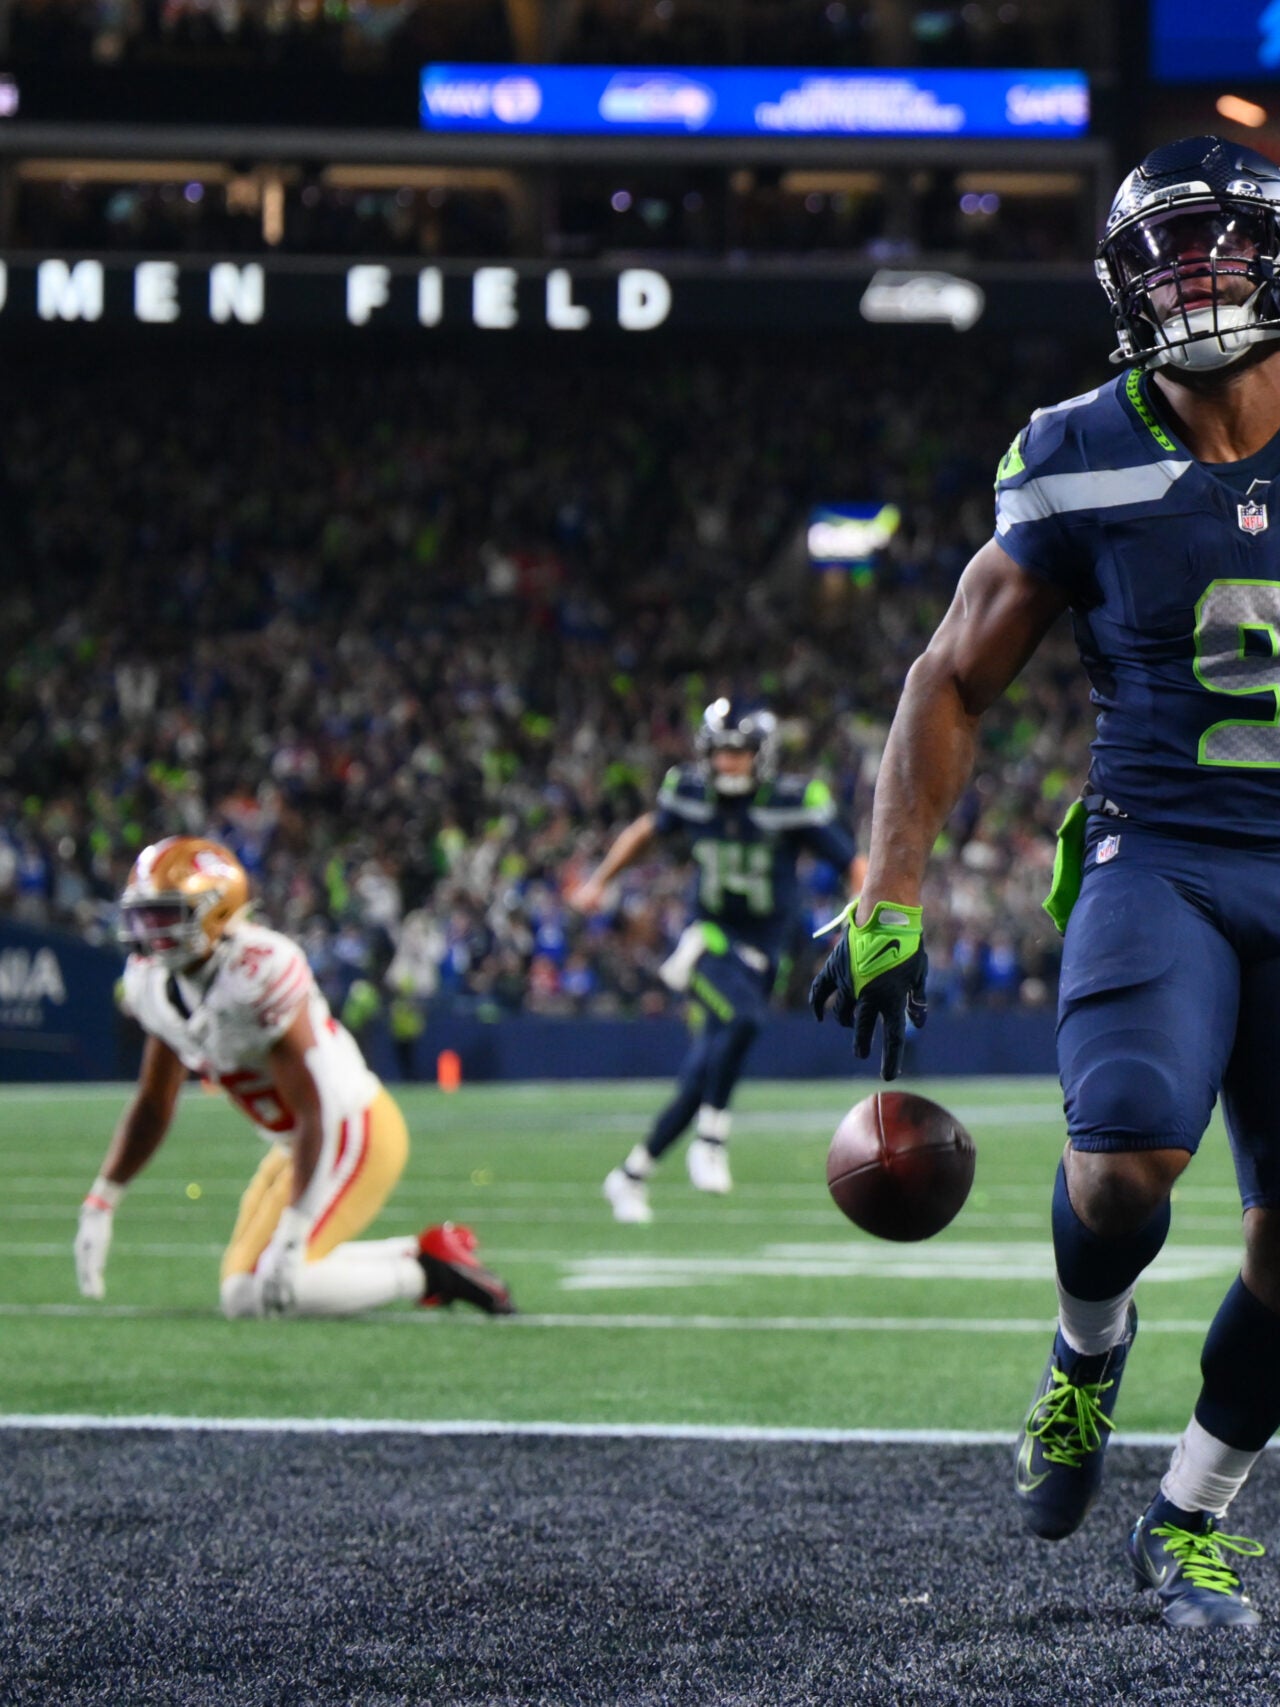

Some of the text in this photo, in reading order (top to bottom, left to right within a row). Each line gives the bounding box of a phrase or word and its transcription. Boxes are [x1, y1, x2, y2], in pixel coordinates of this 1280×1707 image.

[0, 259, 672, 330] MEN FIELD
[692, 838, 774, 914] 14
